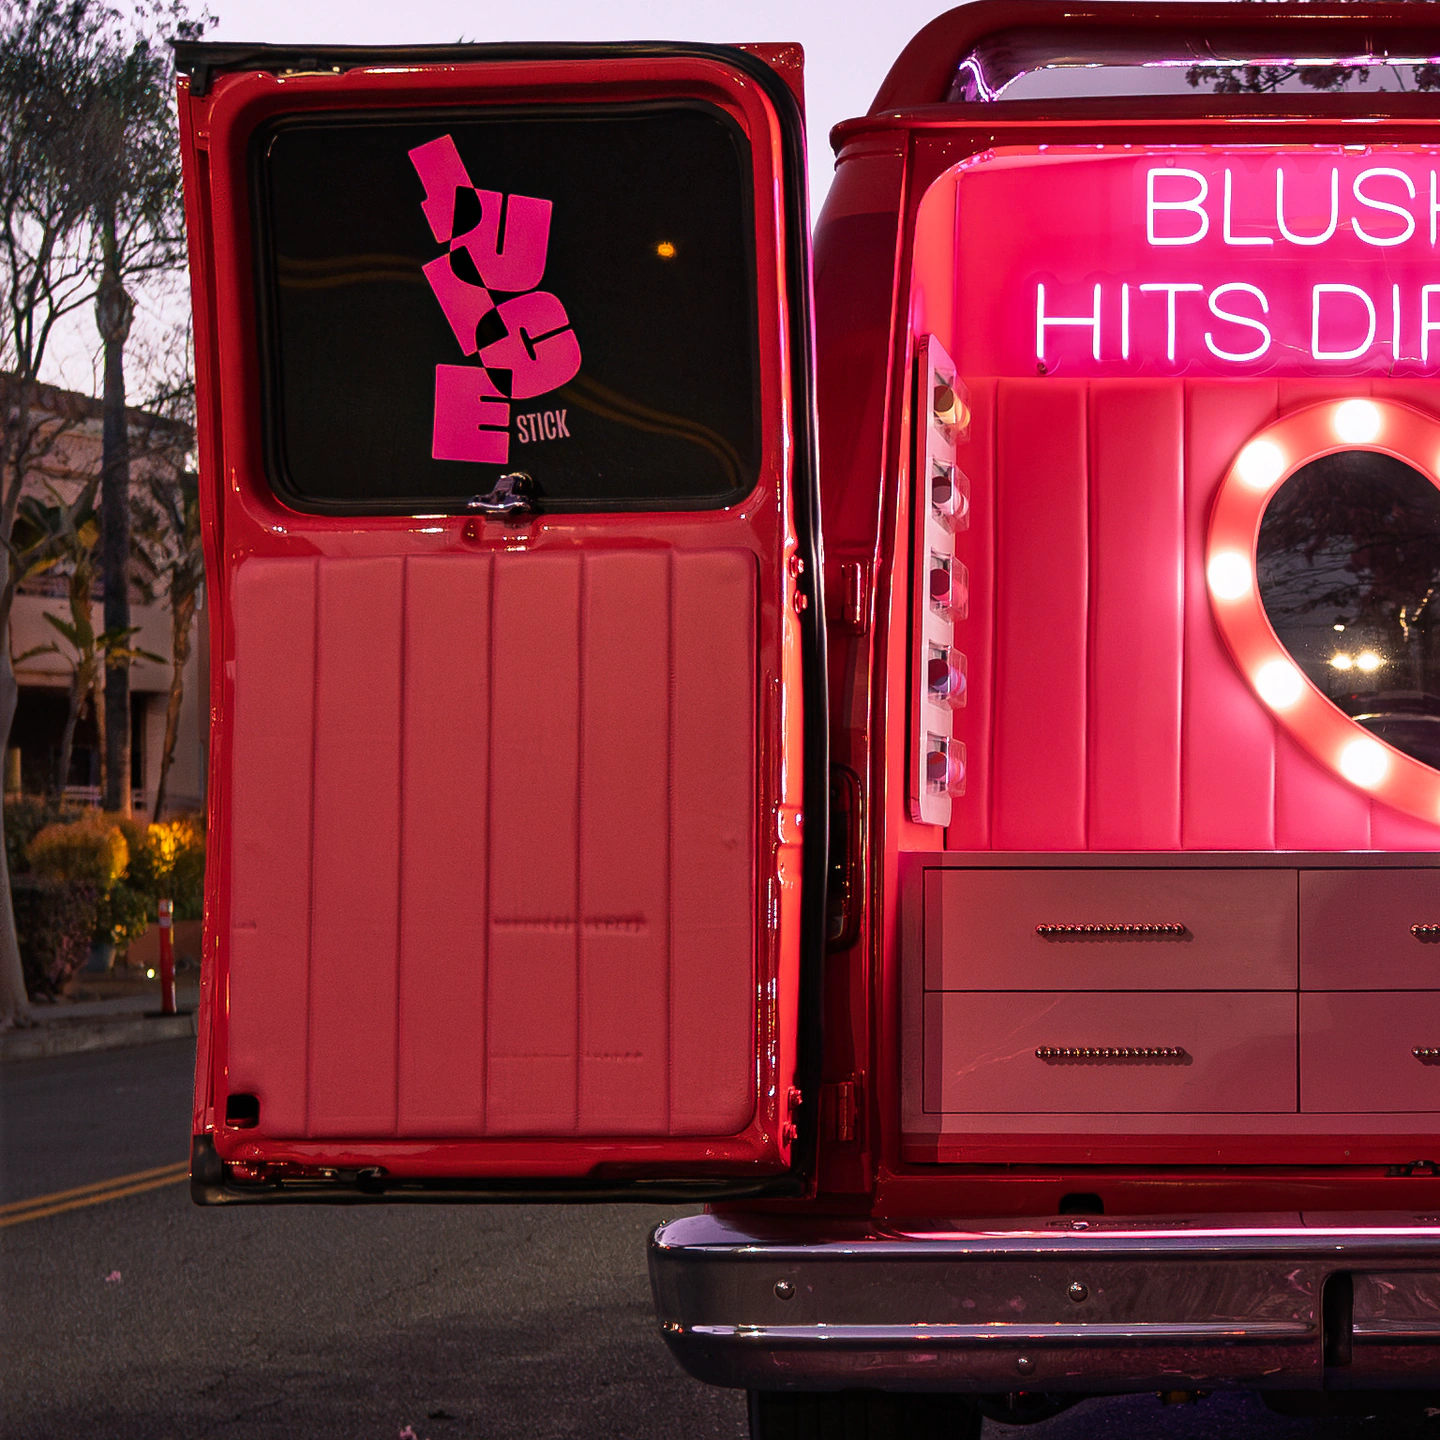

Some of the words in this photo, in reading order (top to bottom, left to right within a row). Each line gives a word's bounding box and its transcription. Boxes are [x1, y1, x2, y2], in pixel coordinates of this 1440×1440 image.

[408, 134, 582, 464] JUICE
[1036, 282, 1272, 362] HITS
[516, 409, 571, 444] STICK
